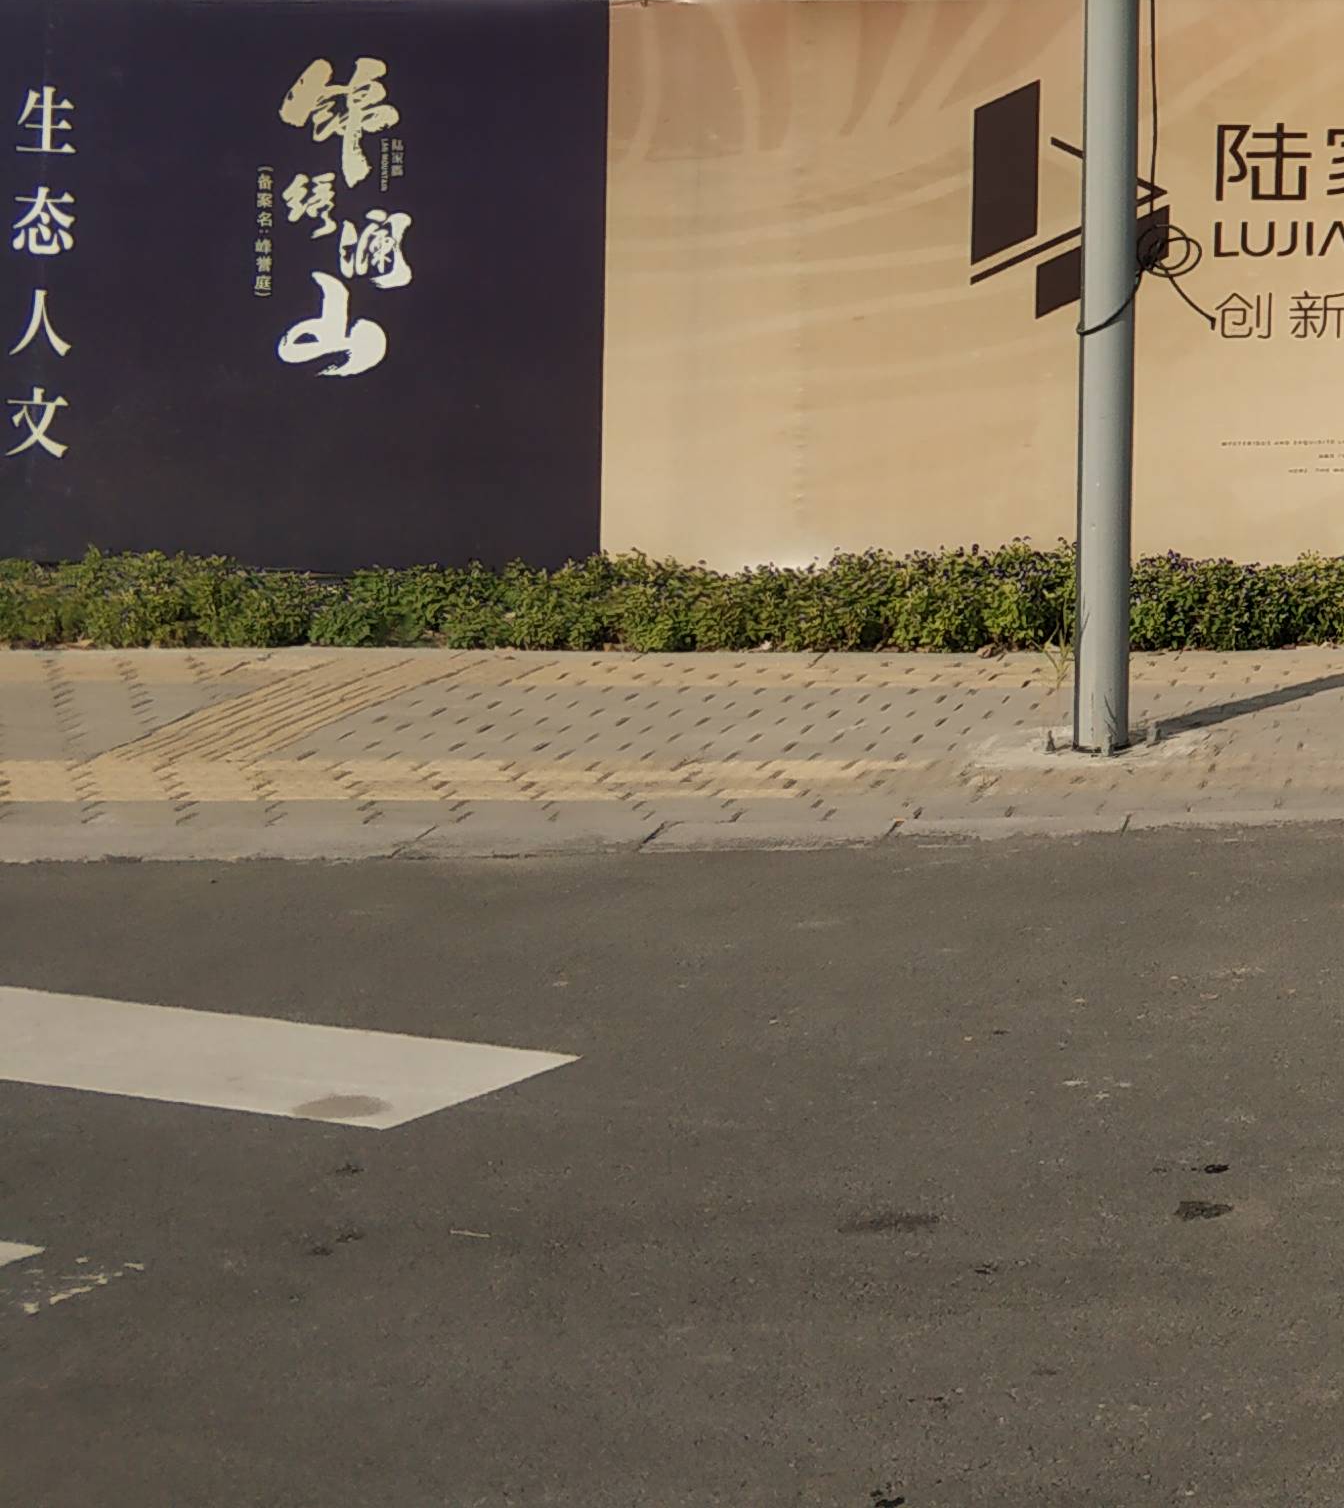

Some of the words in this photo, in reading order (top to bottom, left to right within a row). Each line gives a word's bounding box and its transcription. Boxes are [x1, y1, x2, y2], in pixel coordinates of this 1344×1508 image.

[4, 85, 77, 460] 生态人文
[278, 57, 413, 378] 锦绣澜山
